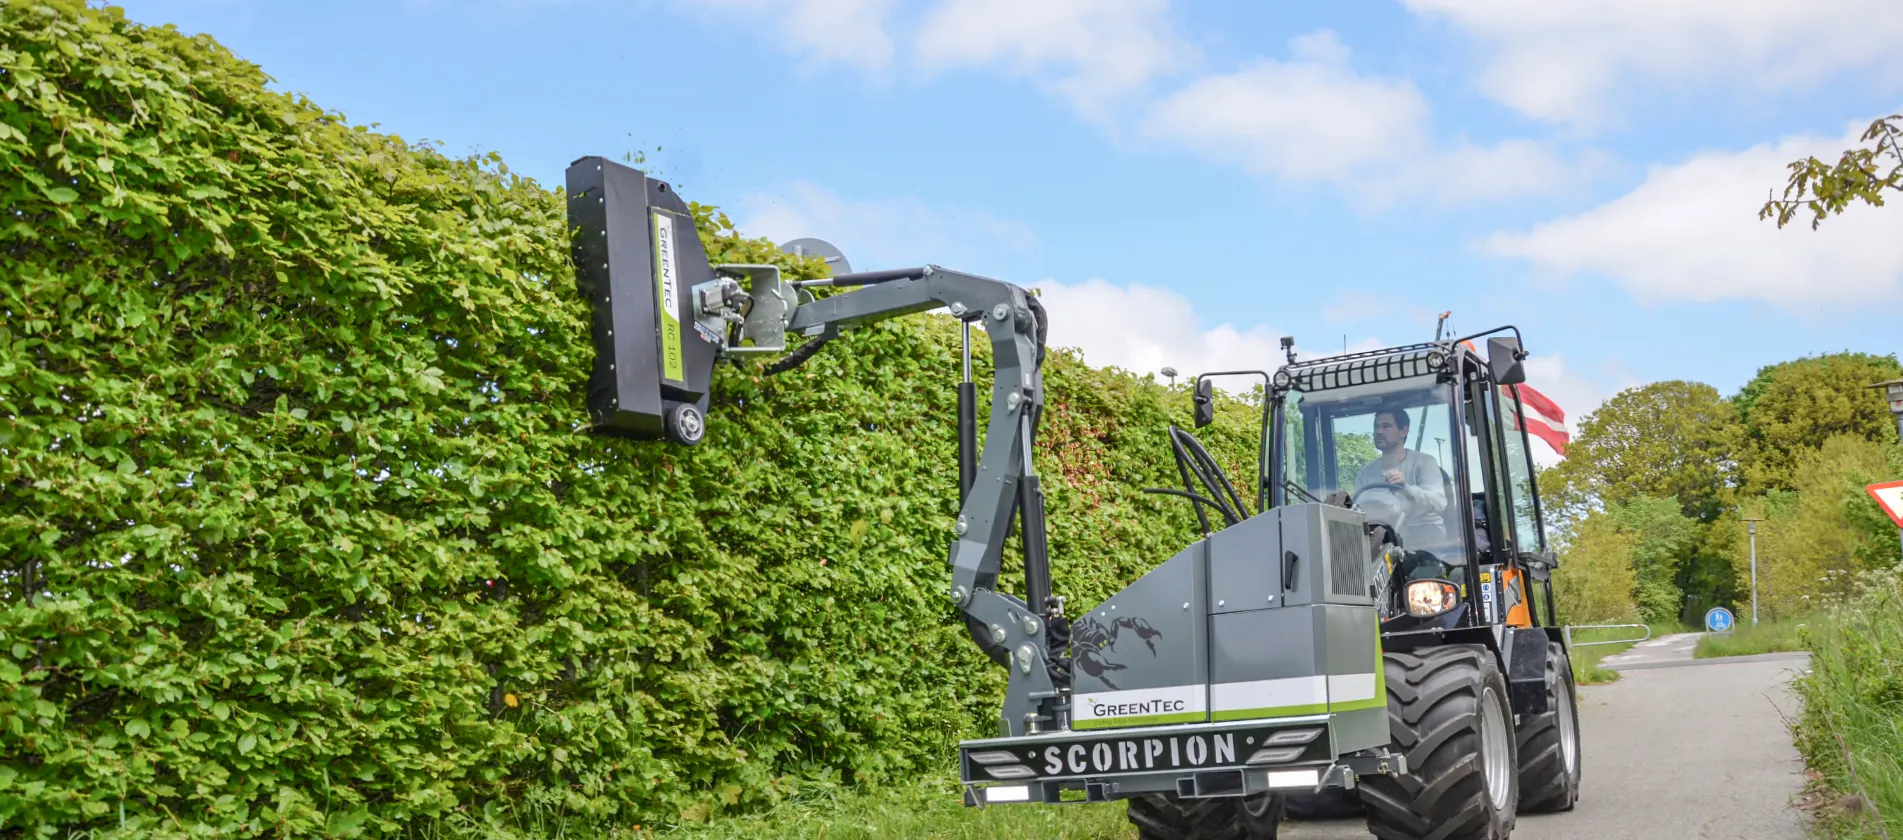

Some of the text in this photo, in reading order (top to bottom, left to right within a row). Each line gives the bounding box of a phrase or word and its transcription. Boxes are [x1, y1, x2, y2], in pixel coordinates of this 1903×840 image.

[667, 323, 677, 369] RC 102
[1044, 733, 1236, 775] SCORPION
